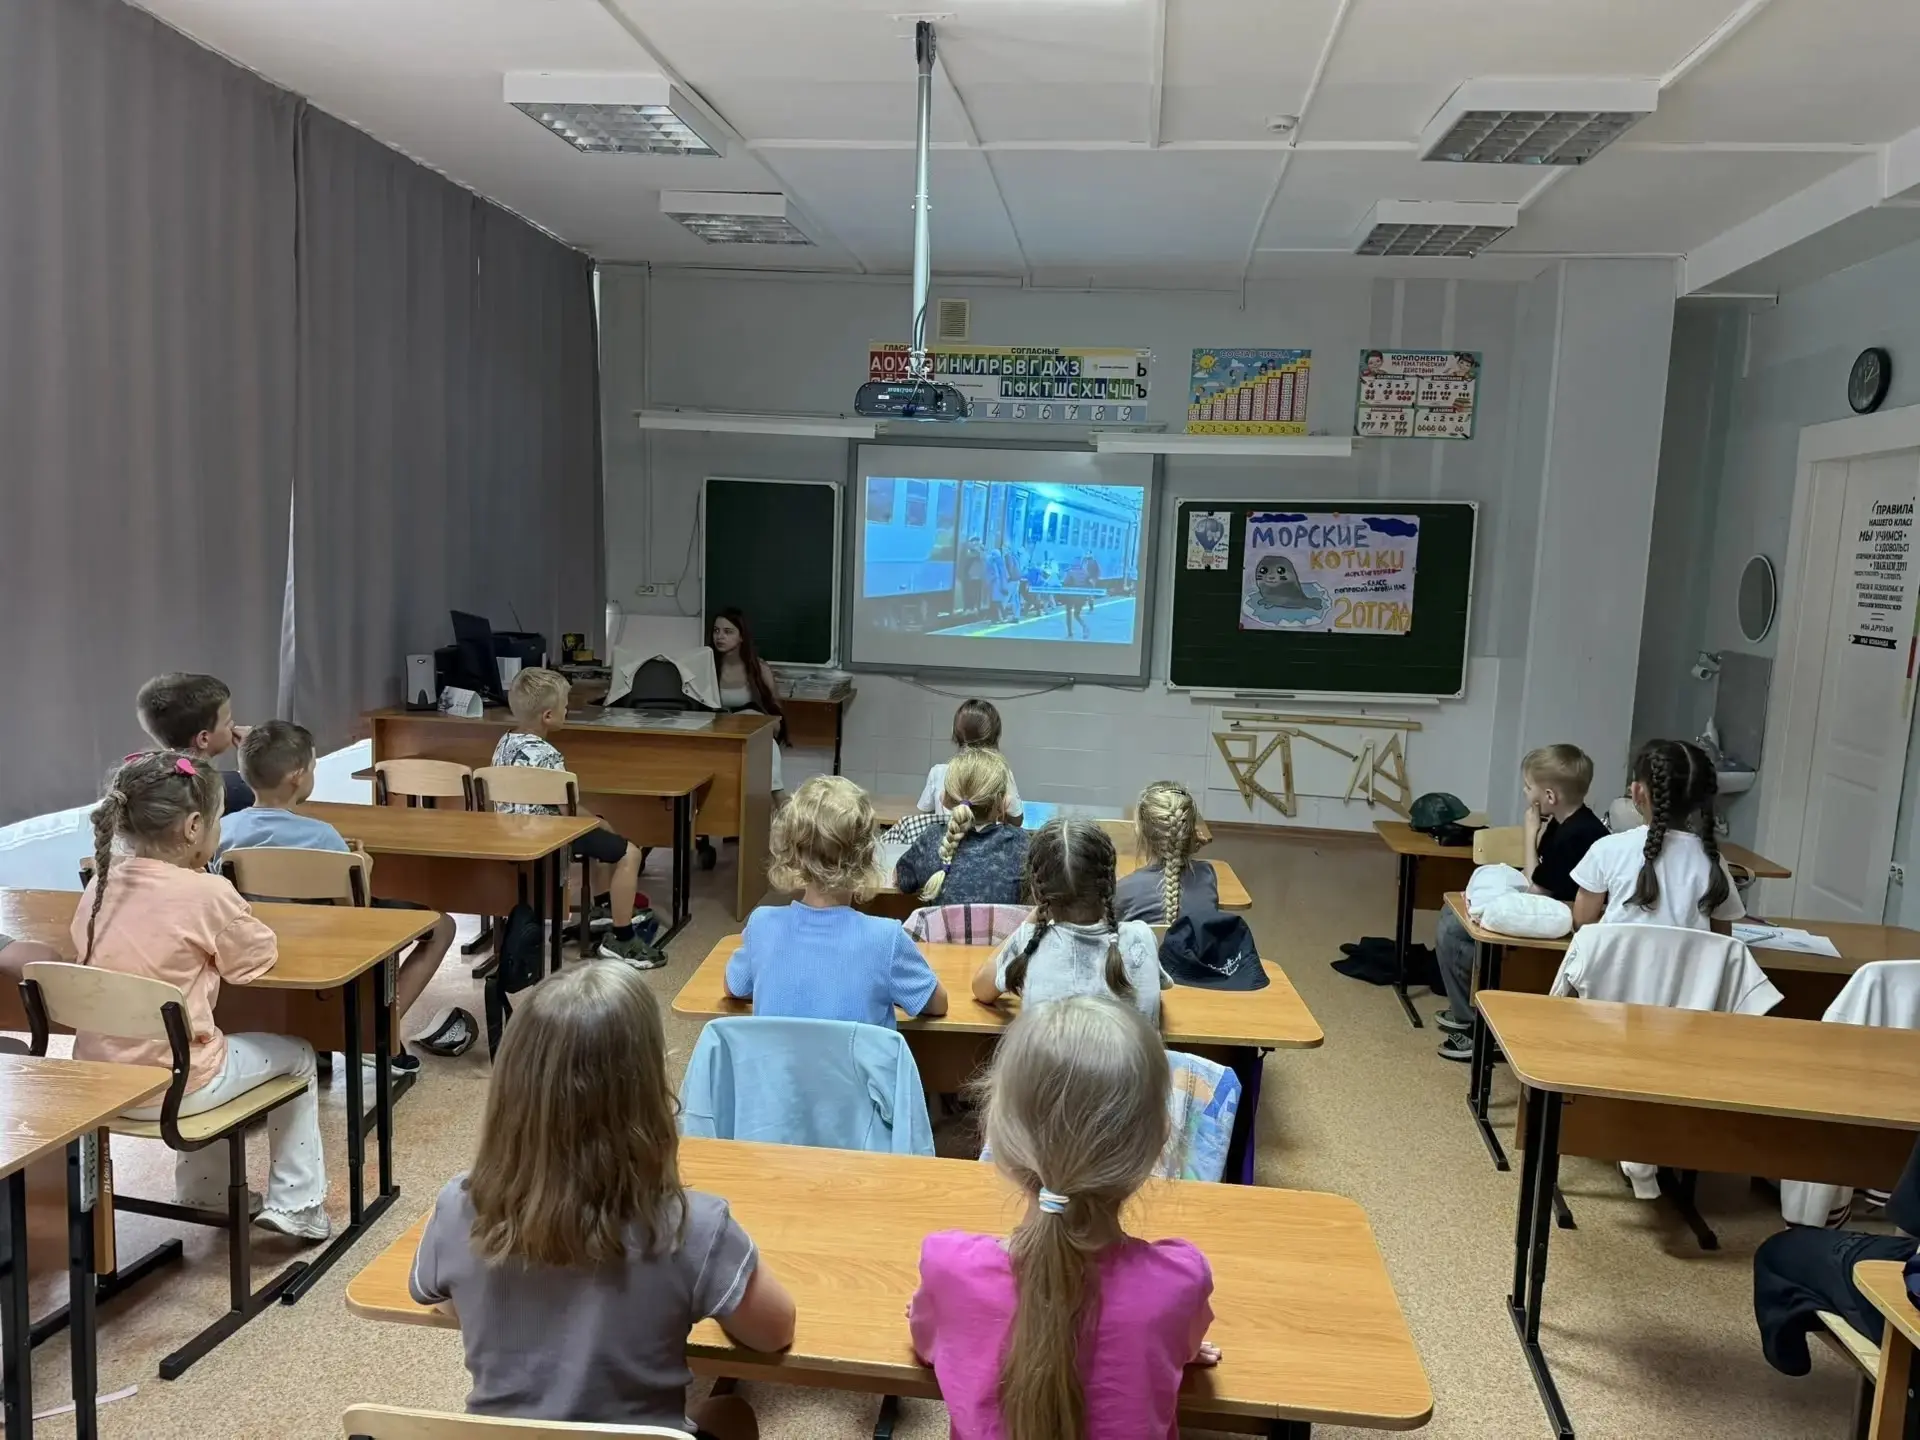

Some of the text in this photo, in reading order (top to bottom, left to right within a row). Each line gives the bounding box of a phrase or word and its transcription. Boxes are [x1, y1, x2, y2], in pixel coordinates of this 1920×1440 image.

[1010, 347, 1060, 355] СОГЛАСНЫЕ
[1391, 354, 1448, 362] КОМПОНЕНТЫ
[992, 403, 1001, 418] 4
[1015, 404, 1026, 419] 5
[1042, 404, 1052, 419] 6
[1068, 404, 1079, 420] 7
[1095, 405, 1105, 420] 8
[1121, 406, 1132, 421] 9
[1875, 504, 1914, 515] ПРАВИЛА
[1868, 518, 1893, 527] НАШЕГО
[1252, 524, 1370, 549] МОРСКИЕ
[1859, 530, 1903, 542] МЫ УЧИМСЯ
[1309, 550, 1405, 571] КОТИКИ
[1870, 624, 1894, 633] ДРУЗЬЯ
